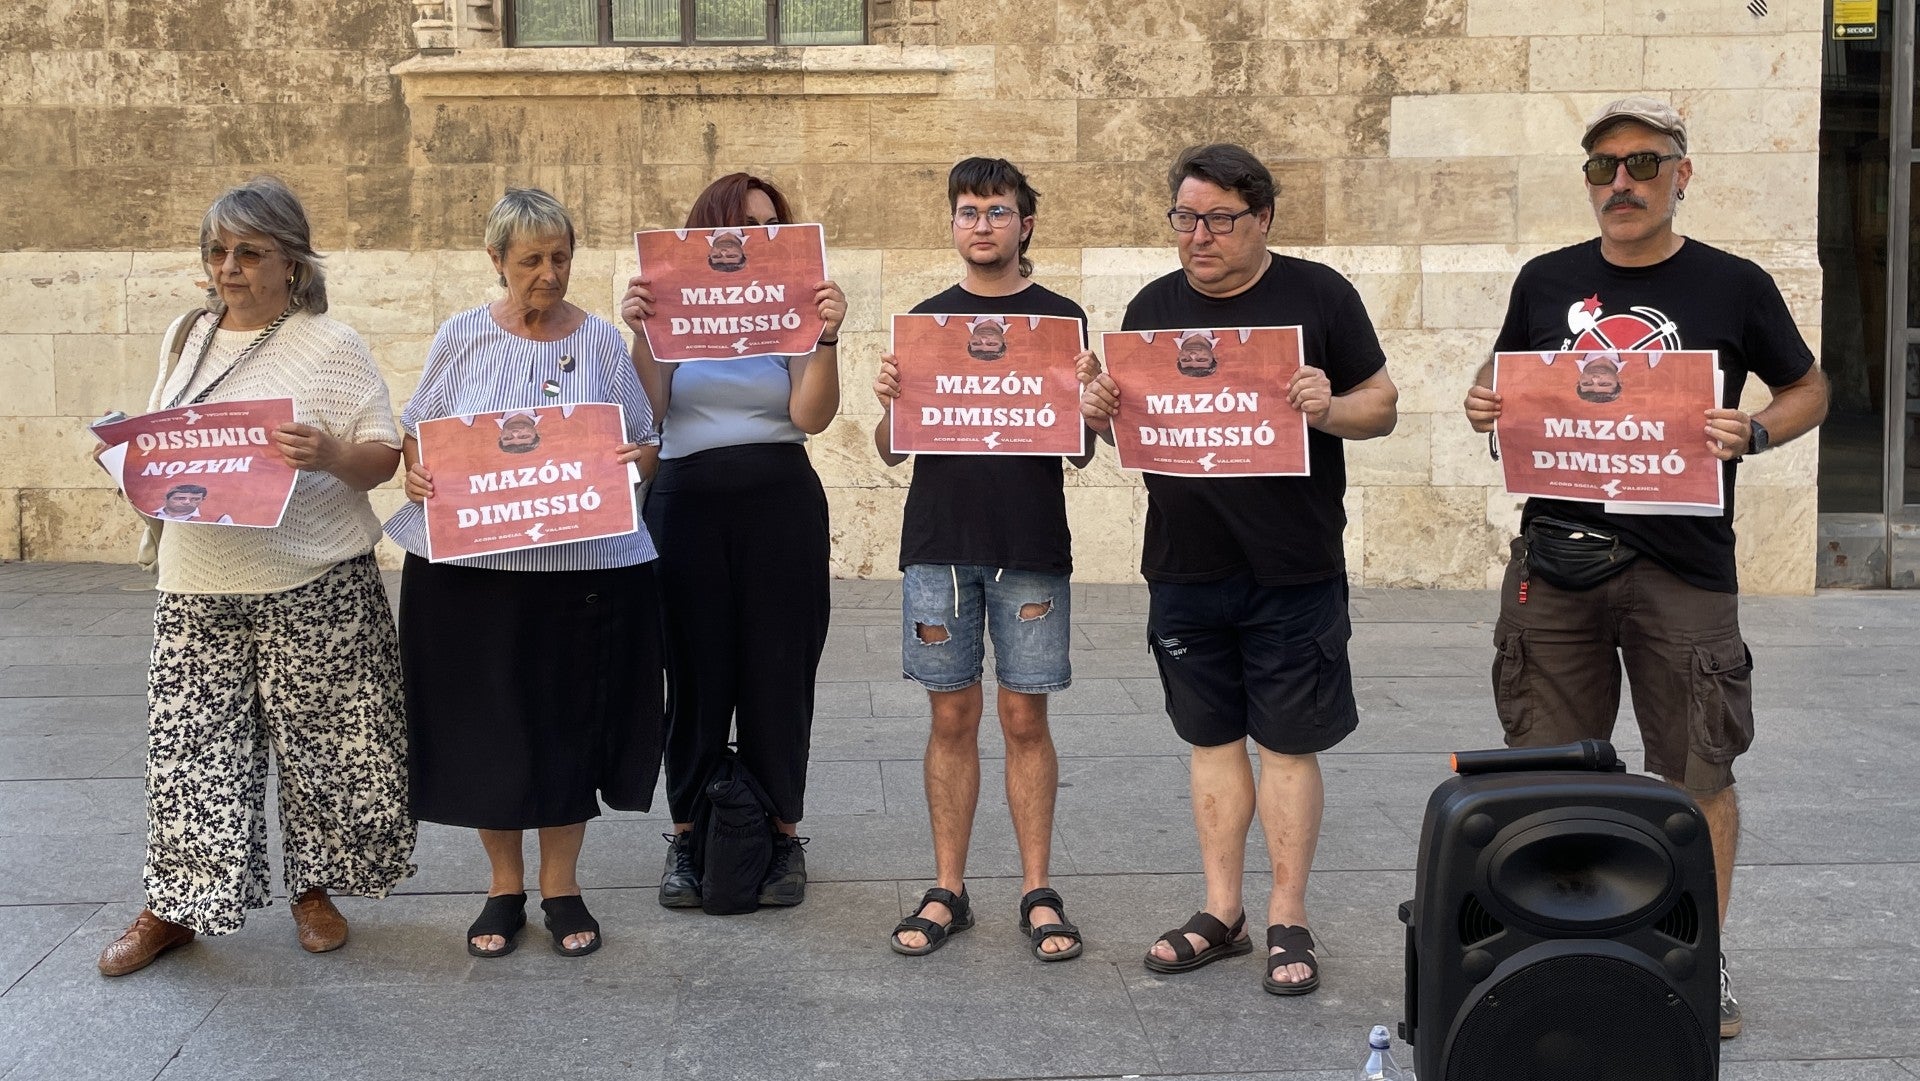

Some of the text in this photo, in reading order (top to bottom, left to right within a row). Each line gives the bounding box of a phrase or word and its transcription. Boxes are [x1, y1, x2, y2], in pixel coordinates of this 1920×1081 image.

[681, 281, 785, 305] MAZÓN
[671, 308, 800, 335] DIMISSIÓ
[936, 370, 1043, 395] MAZÓN
[1146, 387, 1258, 414] MAZÓN
[921, 403, 1056, 427] DIMISSIÓ
[1544, 415, 1664, 441] MAZÓN
[136, 427, 268, 456] DIMISSIÓ
[1139, 420, 1275, 447] DIMISSIÓ
[142, 457, 253, 478] MAZÓN
[1532, 449, 1685, 475] DIMISSIÓ
[469, 458, 582, 494] MAZÓN
[457, 486, 601, 529] DIMISSIÓ
